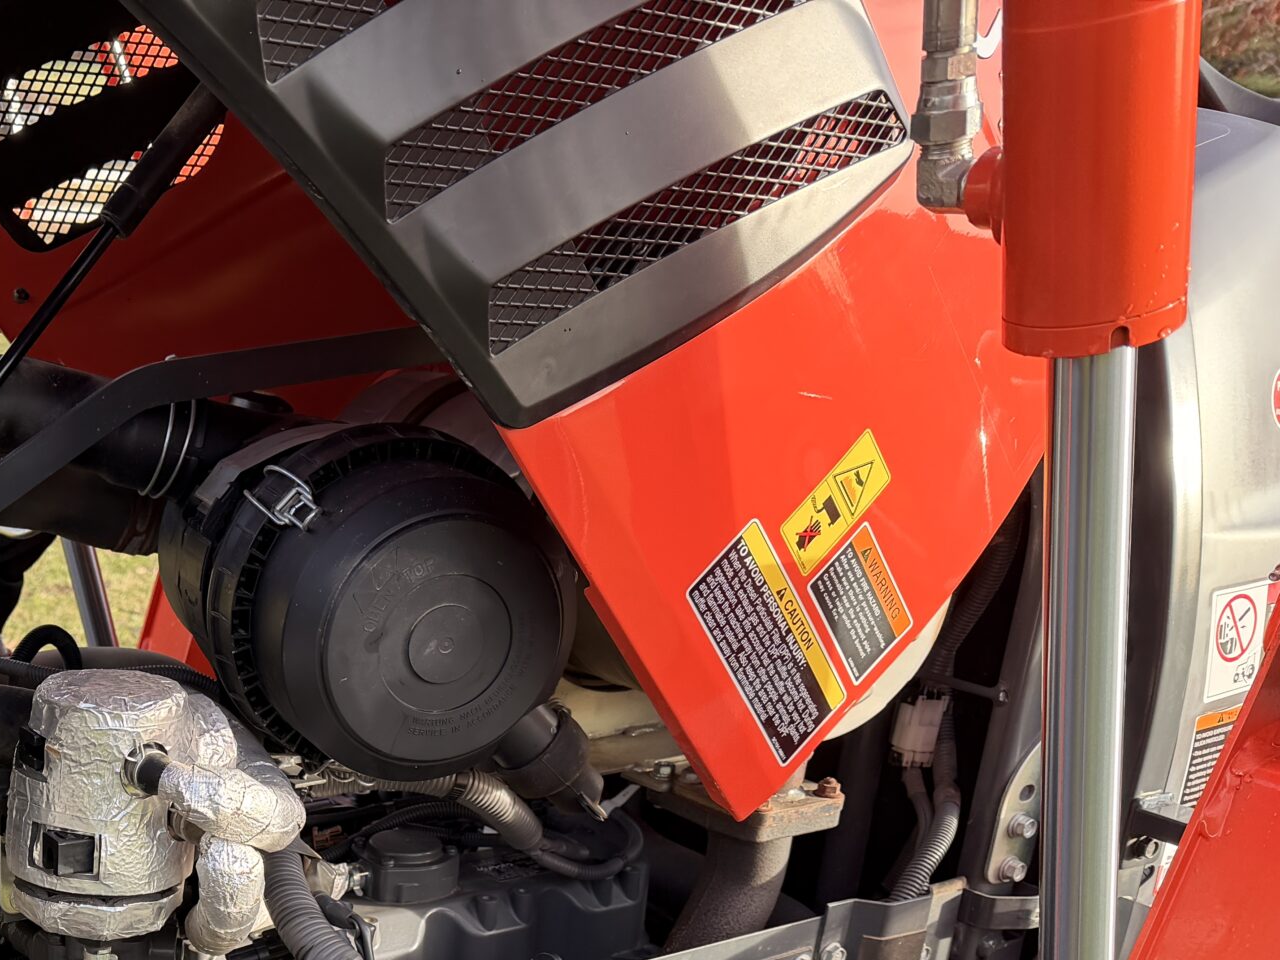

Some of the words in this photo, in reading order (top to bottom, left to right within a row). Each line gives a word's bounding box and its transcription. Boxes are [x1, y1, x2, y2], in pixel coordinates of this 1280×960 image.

[727, 548, 743, 572] When
[705, 572, 718, 589] and
[730, 575, 742, 591] the
[737, 567, 749, 582] the
[839, 553, 850, 571] After
[846, 568, 855, 582] use
[852, 580, 864, 602] and/or
[845, 546, 853, 559] TO
[850, 556, 862, 579] AVOID
[859, 576, 869, 593] FIRE
[865, 590, 880, 617] HAZARD
[698, 579, 711, 597] and
[711, 584, 726, 606] keep
[743, 577, 759, 602] Diesel
[867, 557, 901, 621] WARNING
[691, 587, 708, 613] muffler
[705, 592, 727, 627] flammable
[721, 600, 732, 615] the
[736, 586, 755, 615] exhaust
[736, 538, 749, 557] TO
[743, 553, 764, 588] AVOID
[759, 583, 790, 636] PERSONAL
[784, 631, 808, 670] INJURY:
[702, 608, 717, 630] clean
[734, 603, 746, 622] take
[747, 611, 759, 628] gas
[753, 596, 775, 632] Particulate
[726, 610, 745, 640] machine
[741, 617, 753, 633] into
[755, 621, 767, 638] and
[783, 597, 814, 651] CAUTION
[712, 625, 724, 643] and
[747, 628, 765, 656] account
[761, 633, 772, 648] the
[769, 627, 783, 647] Filter
[717, 638, 732, 660] away
[738, 636, 753, 657] away
[766, 643, 779, 661] DPF
[777, 642, 792, 664] (DPF)
[727, 653, 740, 672] from
[737, 649, 749, 667] Also
[748, 650, 761, 669] from
[759, 651, 771, 667] that
[786, 659, 795, 670] is
[743, 663, 757, 683] keep
[756, 664, 769, 684] other
[765, 662, 776, 677] the
[774, 656, 790, 681] muffler
[789, 664, 798, 676] in
[735, 666, 756, 701] flammable
[752, 677, 762, 692] the
[771, 672, 786, 696] muffler
[792, 671, 803, 686] the
[757, 687, 769, 705] area
[784, 675, 801, 702] become
[781, 691, 791, 706] will
[786, 700, 795, 713] be
[796, 680, 820, 720] regenerating
[764, 699, 777, 718] near
[789, 709, 801, 726] very
[771, 712, 782, 727] the
[796, 719, 807, 734] hot
[799, 708, 816, 733] During
[776, 721, 789, 739] DPF
